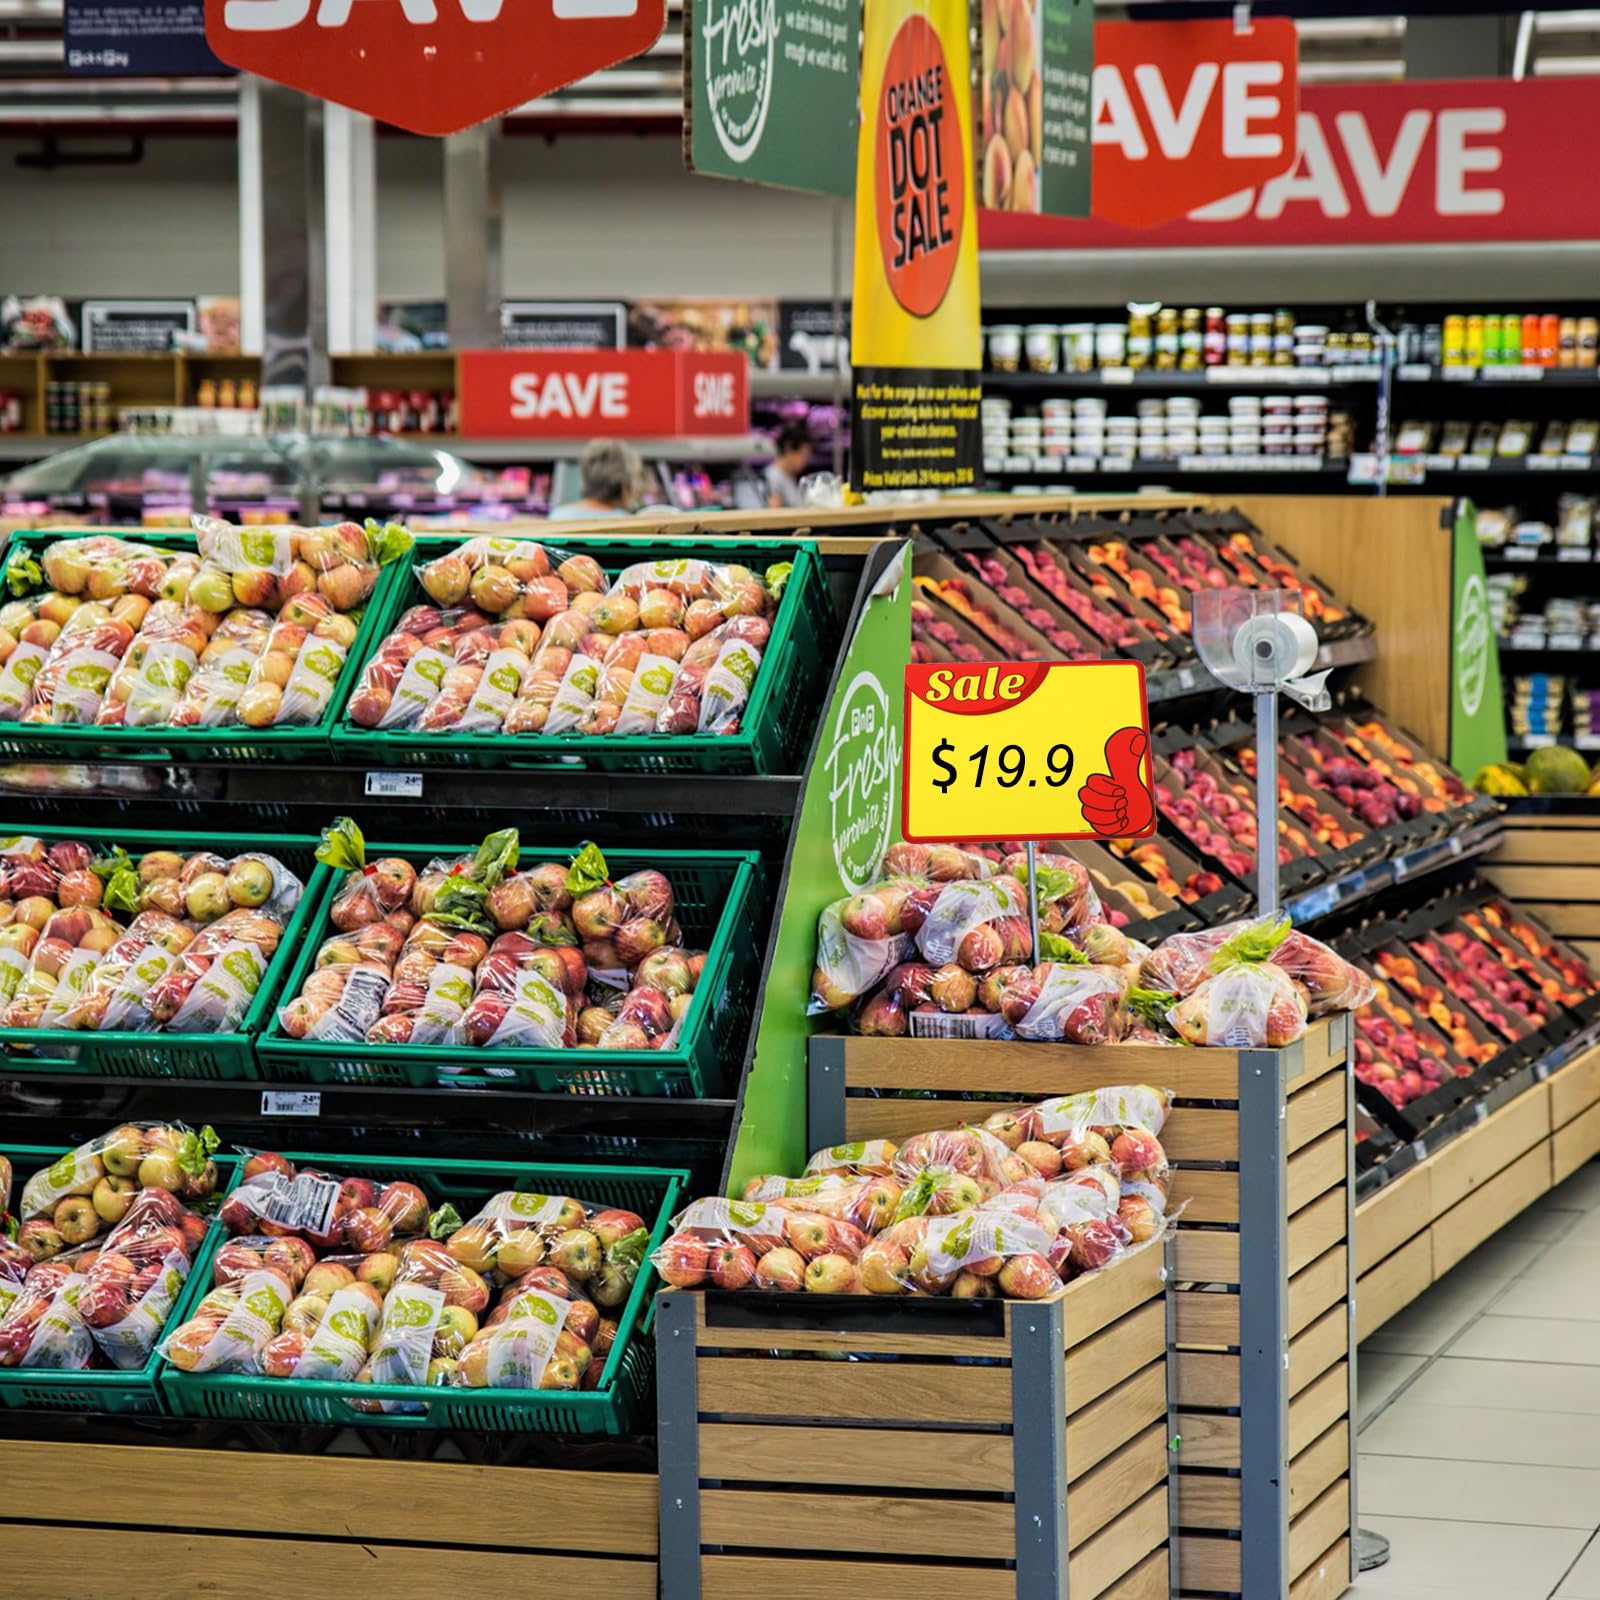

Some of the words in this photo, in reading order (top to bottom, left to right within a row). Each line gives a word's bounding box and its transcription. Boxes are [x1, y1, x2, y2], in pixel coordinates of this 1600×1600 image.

[886, 65, 943, 124] ORANGE
[1092, 62, 1283, 160] AVE
[888, 107, 943, 201] DOT
[1187, 107, 1506, 221] AVE
[892, 180, 953, 269] SALE
[510, 372, 630, 418] SAVE
[693, 372, 735, 418] SAVE
[925, 666, 1025, 702] Sale
[824, 693, 902, 817] Fresh
[931, 738, 1074, 794] $19.9
